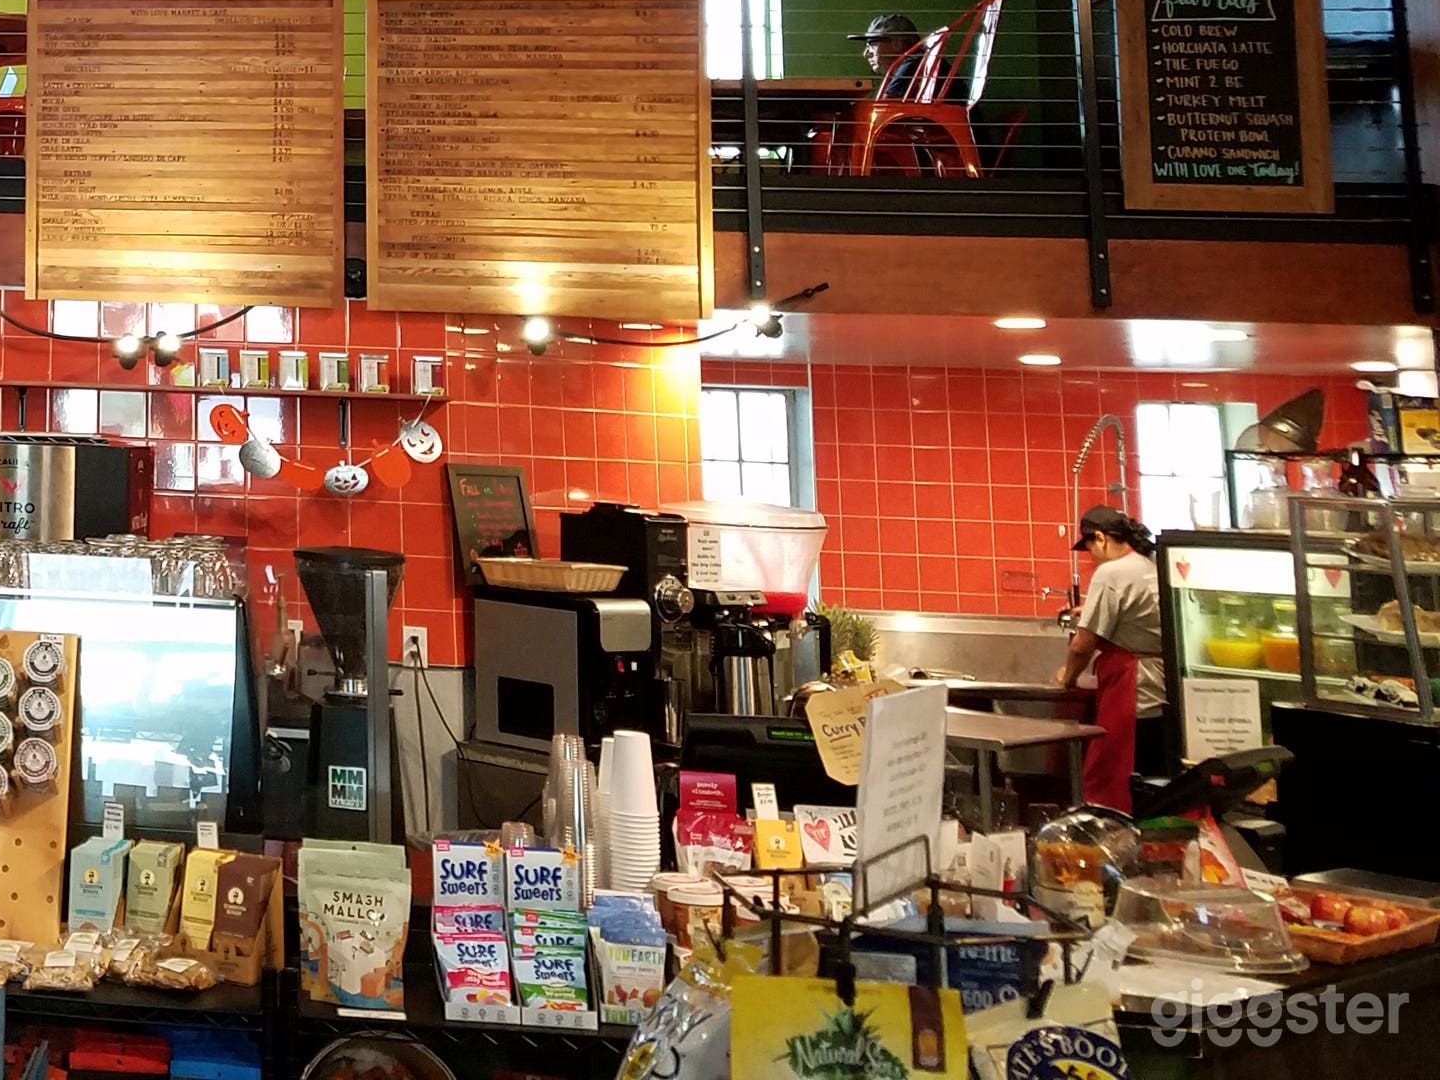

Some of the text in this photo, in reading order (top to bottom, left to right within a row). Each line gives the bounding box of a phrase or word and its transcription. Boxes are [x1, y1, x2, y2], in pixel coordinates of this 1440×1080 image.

[171, 9, 200, 17] MARKET
[1162, 24, 1237, 38] COLD BREW
[1162, 41, 1274, 54] HORCHATA LATTE
[1164, 58, 1239, 71] THE FUEGO
[1165, 76, 1200, 89] MINT
[1210, 76, 1219, 88] 2
[1167, 94, 1267, 108] TURKEY MELT
[1167, 113, 1293, 127] BUTTERNUT SQUASH
[1181, 128, 1270, 143] PROTEIN BOWL
[1167, 145, 1280, 161] CUBANO SANDWICH
[1153, 163, 1189, 178] WITH
[1193, 163, 1223, 178] LOVE
[1227, 166, 1248, 177] ONE
[821, 723, 861, 739] Curry
[440, 858, 488, 881] SURF
[514, 864, 562, 887] SURF
[332, 890, 384, 907] SMASH
[456, 943, 497, 959] SURF
[533, 958, 574, 972] SURF
[794, 1035, 865, 1078] Natural
